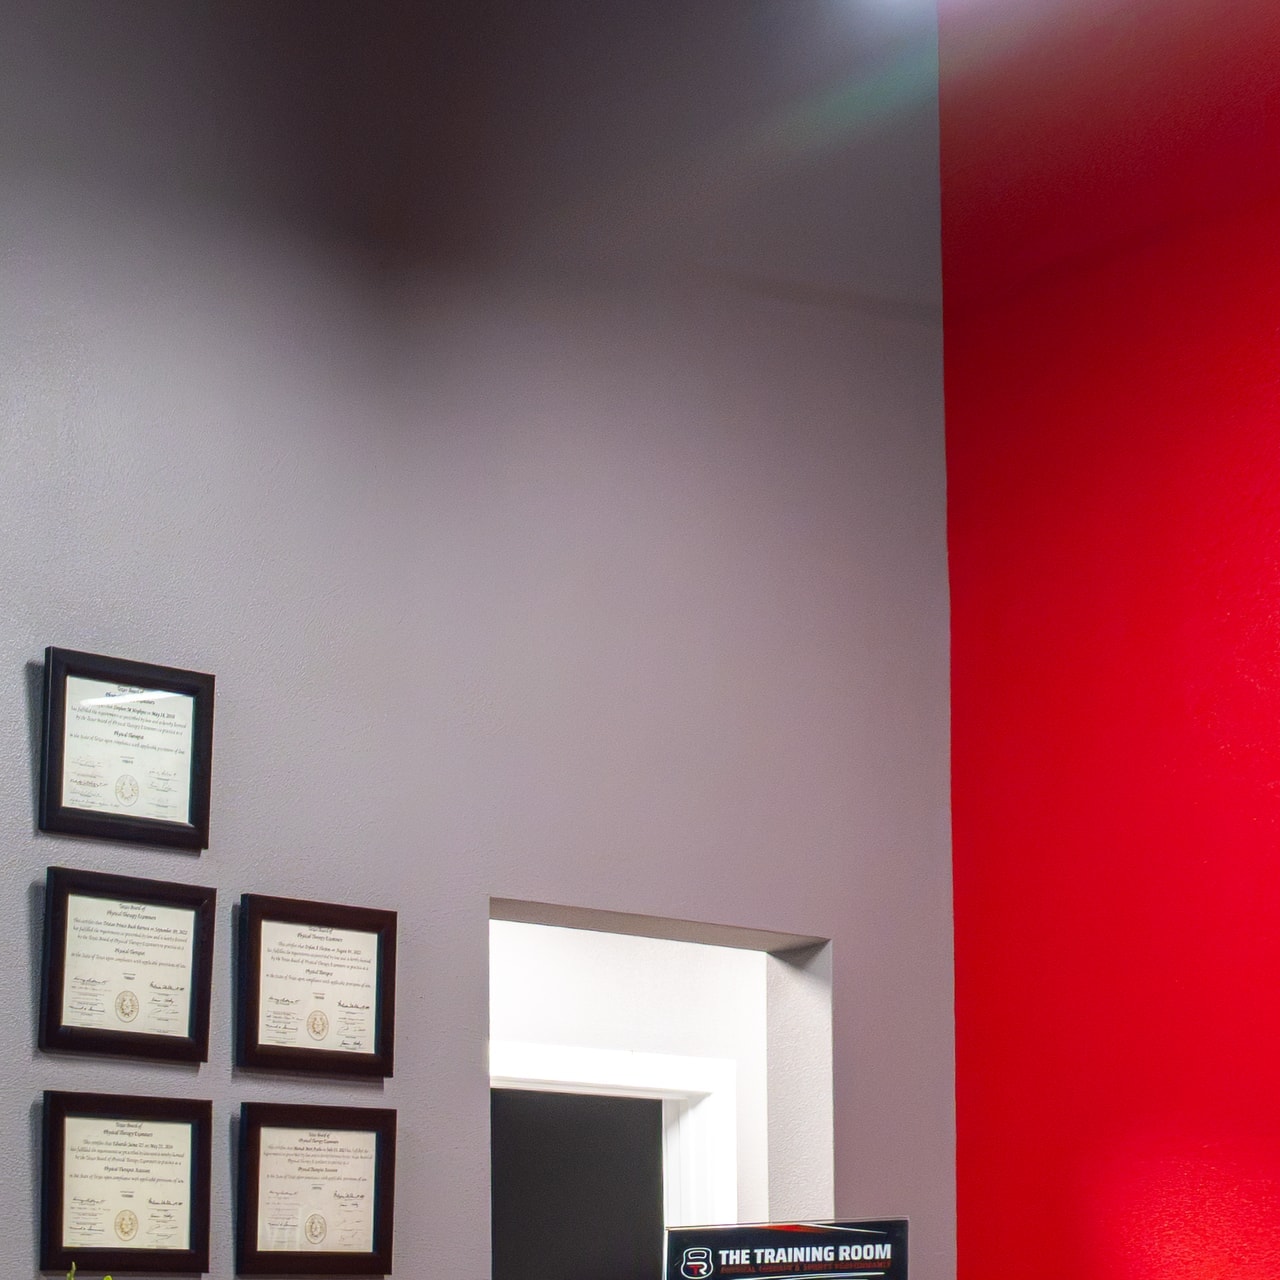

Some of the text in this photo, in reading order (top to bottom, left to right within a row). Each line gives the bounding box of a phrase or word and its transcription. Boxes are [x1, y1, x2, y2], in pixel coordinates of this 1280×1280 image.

[719, 1244, 892, 1265] THE TRAINING ROOM
